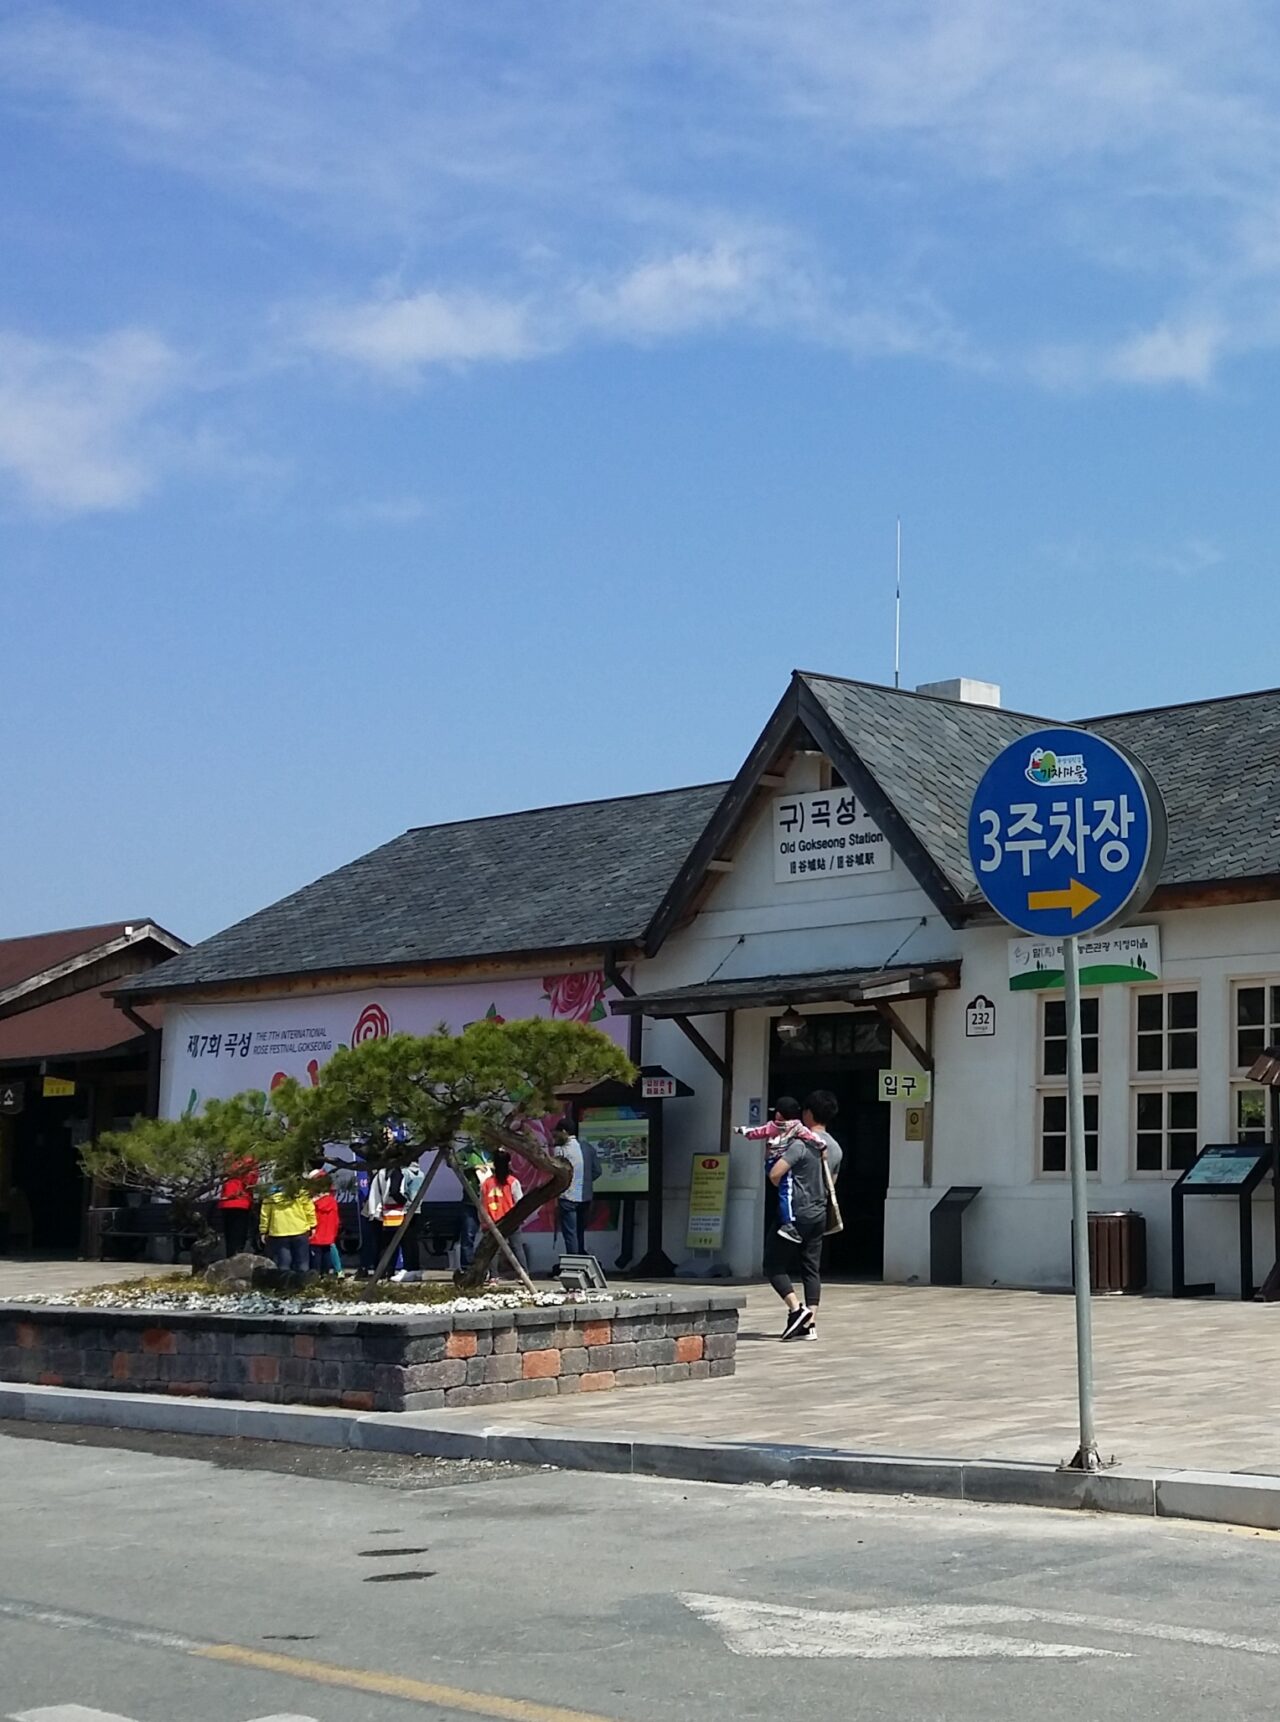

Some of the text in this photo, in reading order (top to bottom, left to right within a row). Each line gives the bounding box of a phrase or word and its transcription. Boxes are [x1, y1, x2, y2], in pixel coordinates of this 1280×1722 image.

[1041, 765, 1086, 782] 기차마을
[779, 796, 870, 833] 구)곡성
[780, 832, 884, 854] Old Gokseong Station
[979, 794, 1135, 876] 3주차장
[971, 1012, 990, 1025] 232
[187, 1031, 253, 1058] 제7회 곡성
[256, 1032, 267, 1041] THE
[280, 1027, 327, 1040] INTERNATIONAL
[253, 1044, 269, 1055] ROSE
[884, 1075, 917, 1096] 입구
